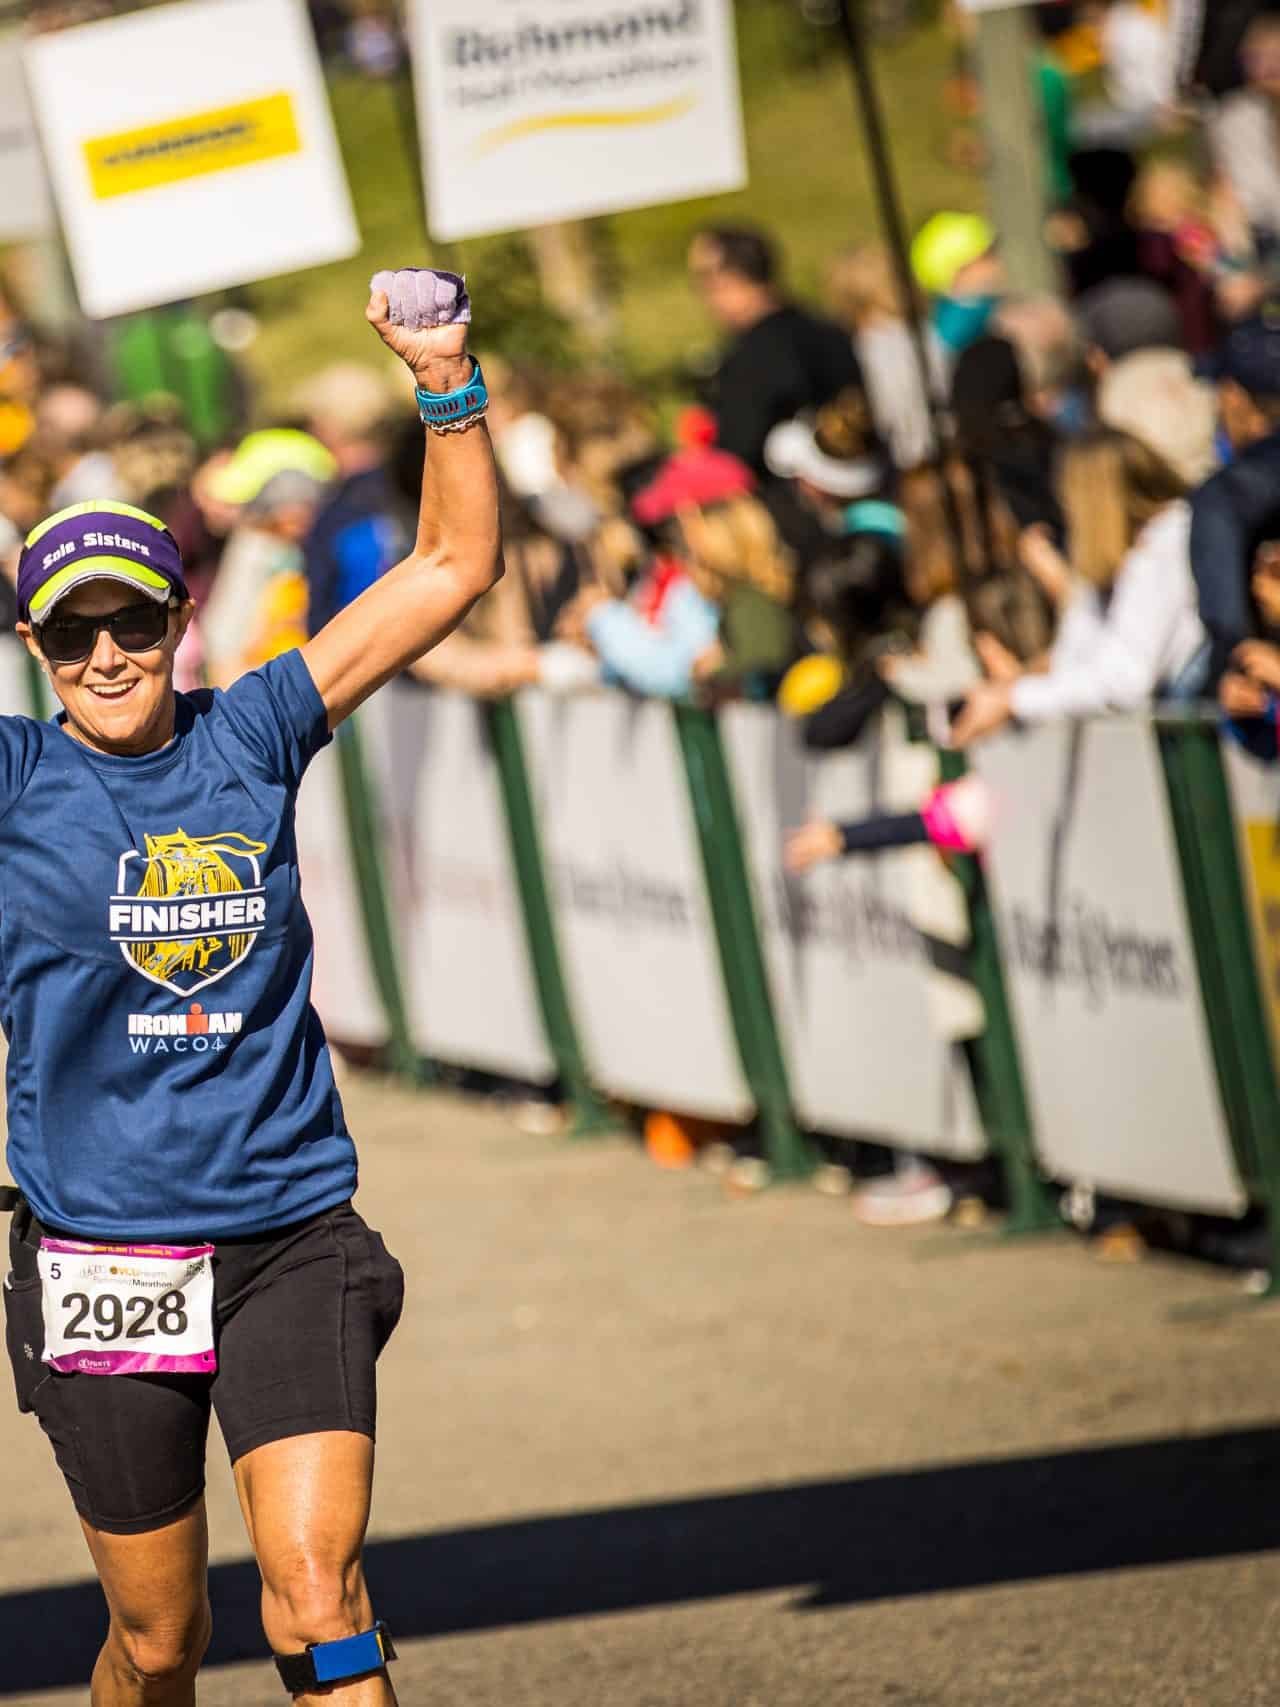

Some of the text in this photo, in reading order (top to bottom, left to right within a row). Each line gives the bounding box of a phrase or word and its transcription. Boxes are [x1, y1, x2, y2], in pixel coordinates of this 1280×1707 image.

[42, 532, 150, 570] Sole Sisters
[109, 896, 267, 933] FINISHER
[127, 1003, 242, 1036] IRONMAN
[50, 1263, 62, 1280] 5
[132, 1279, 173, 1290] Marathon
[62, 1289, 189, 1342] 2928
